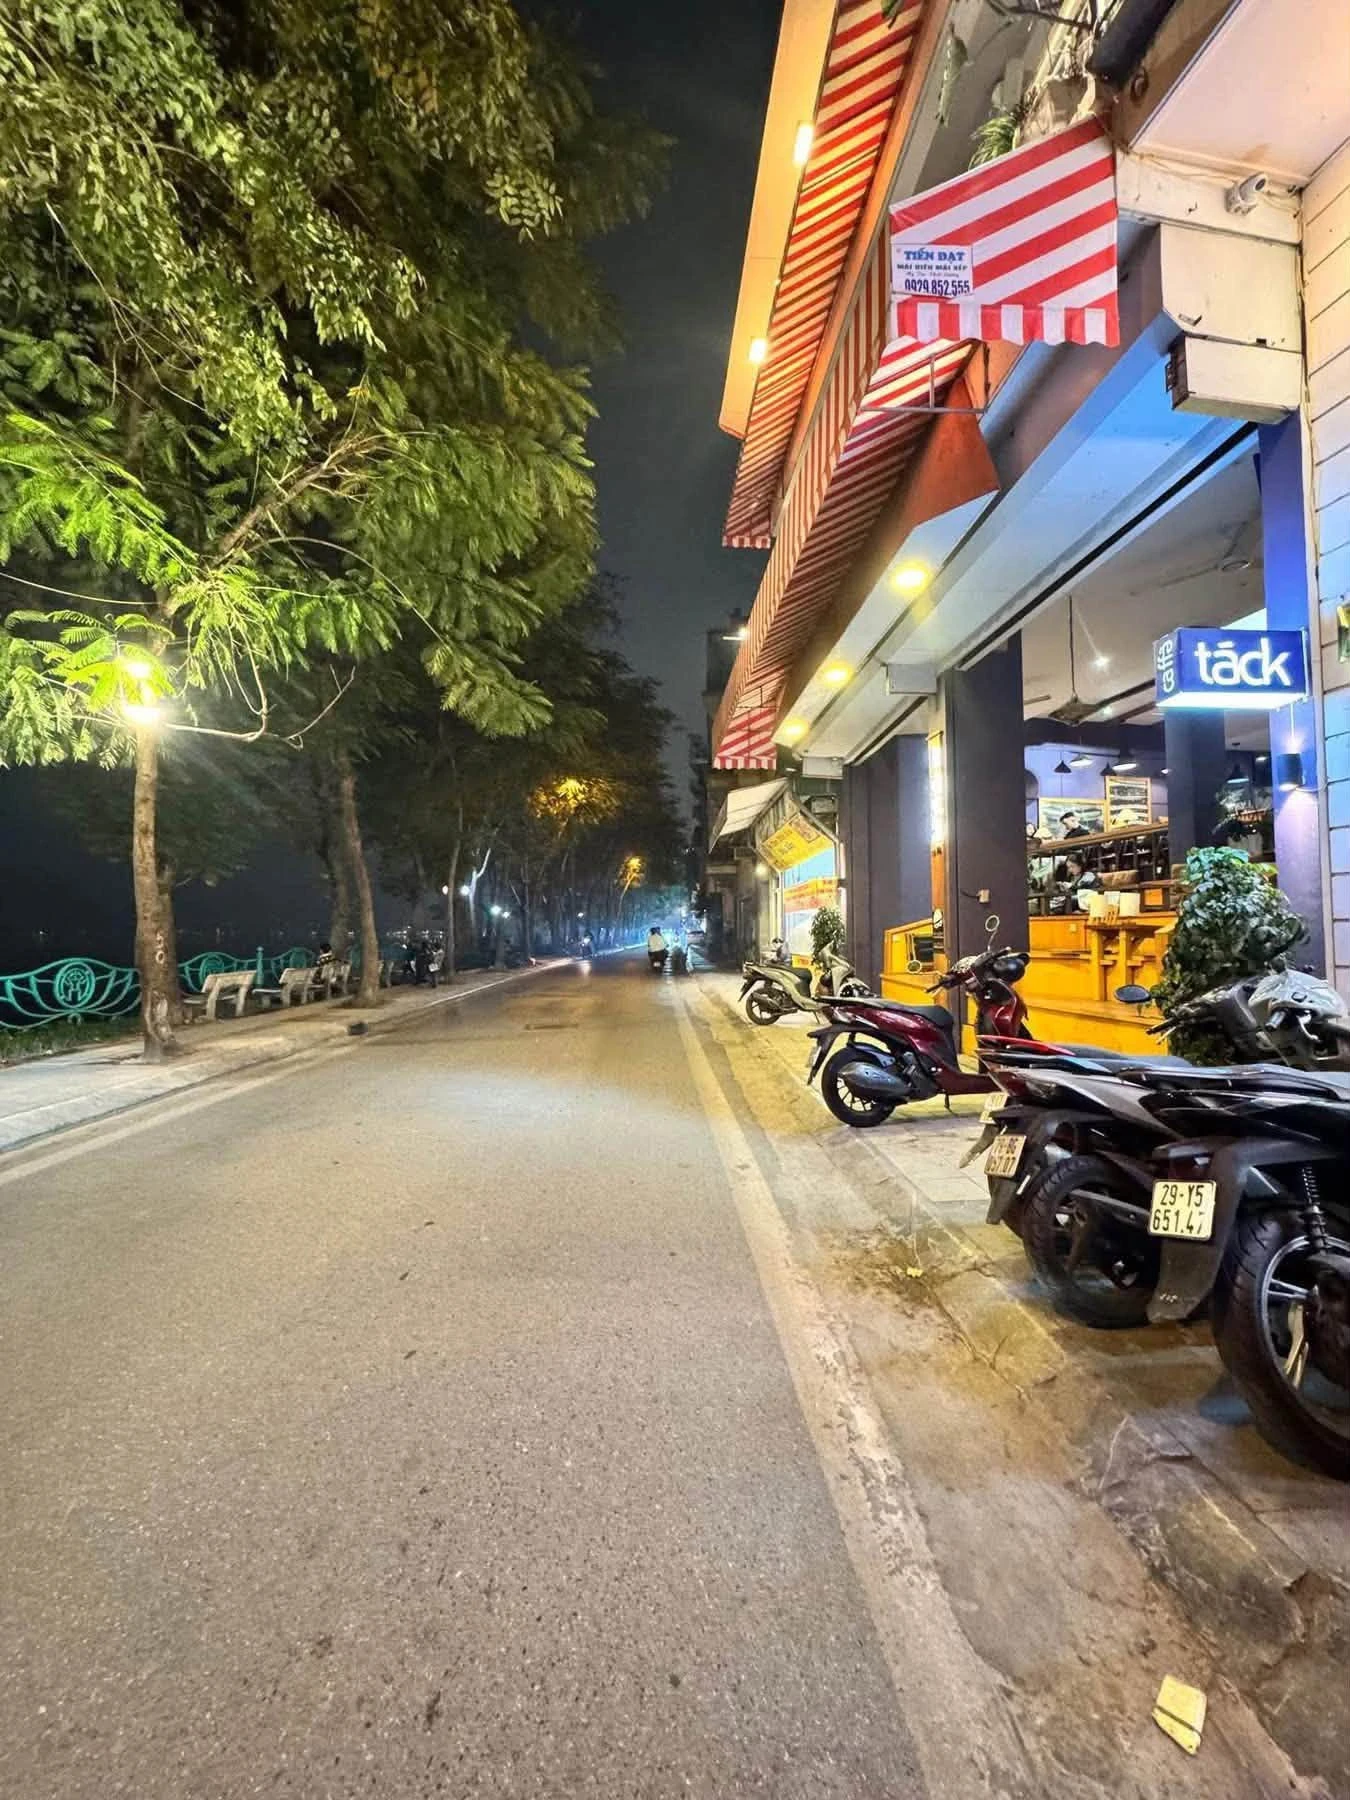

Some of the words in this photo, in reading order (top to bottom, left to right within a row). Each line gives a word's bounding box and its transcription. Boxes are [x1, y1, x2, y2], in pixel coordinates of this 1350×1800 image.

[904, 247, 934, 261] TIẾN
[938, 251, 965, 265] ĐẠT
[1160, 1184, 1204, 1207] 29-Y5
